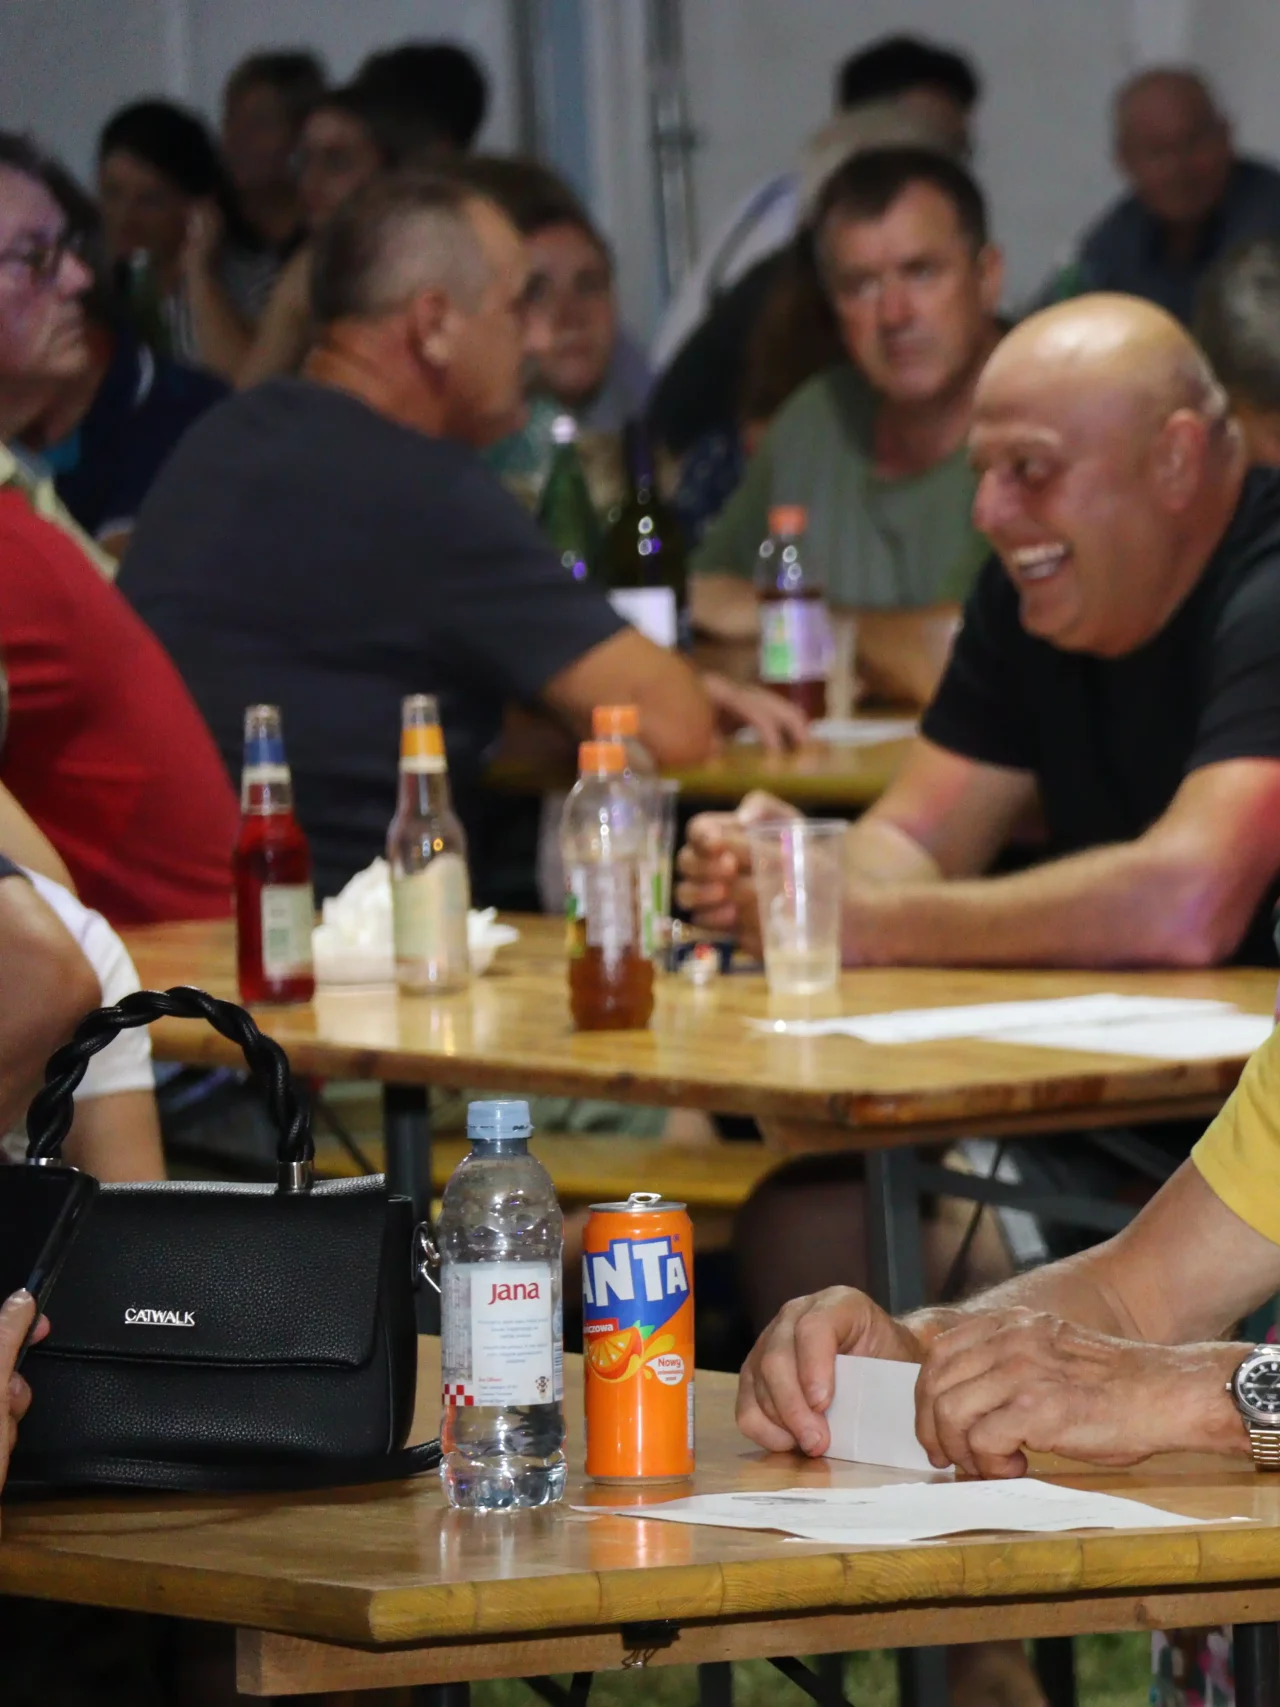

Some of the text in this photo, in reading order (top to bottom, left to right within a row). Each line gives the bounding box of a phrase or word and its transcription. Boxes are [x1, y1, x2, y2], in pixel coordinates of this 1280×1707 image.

[583, 1241, 688, 1307] ANTA
[125, 1308, 195, 1325] CATWALK
[584, 1324, 614, 1333] czowa
[658, 1358, 682, 1368] Nowy
